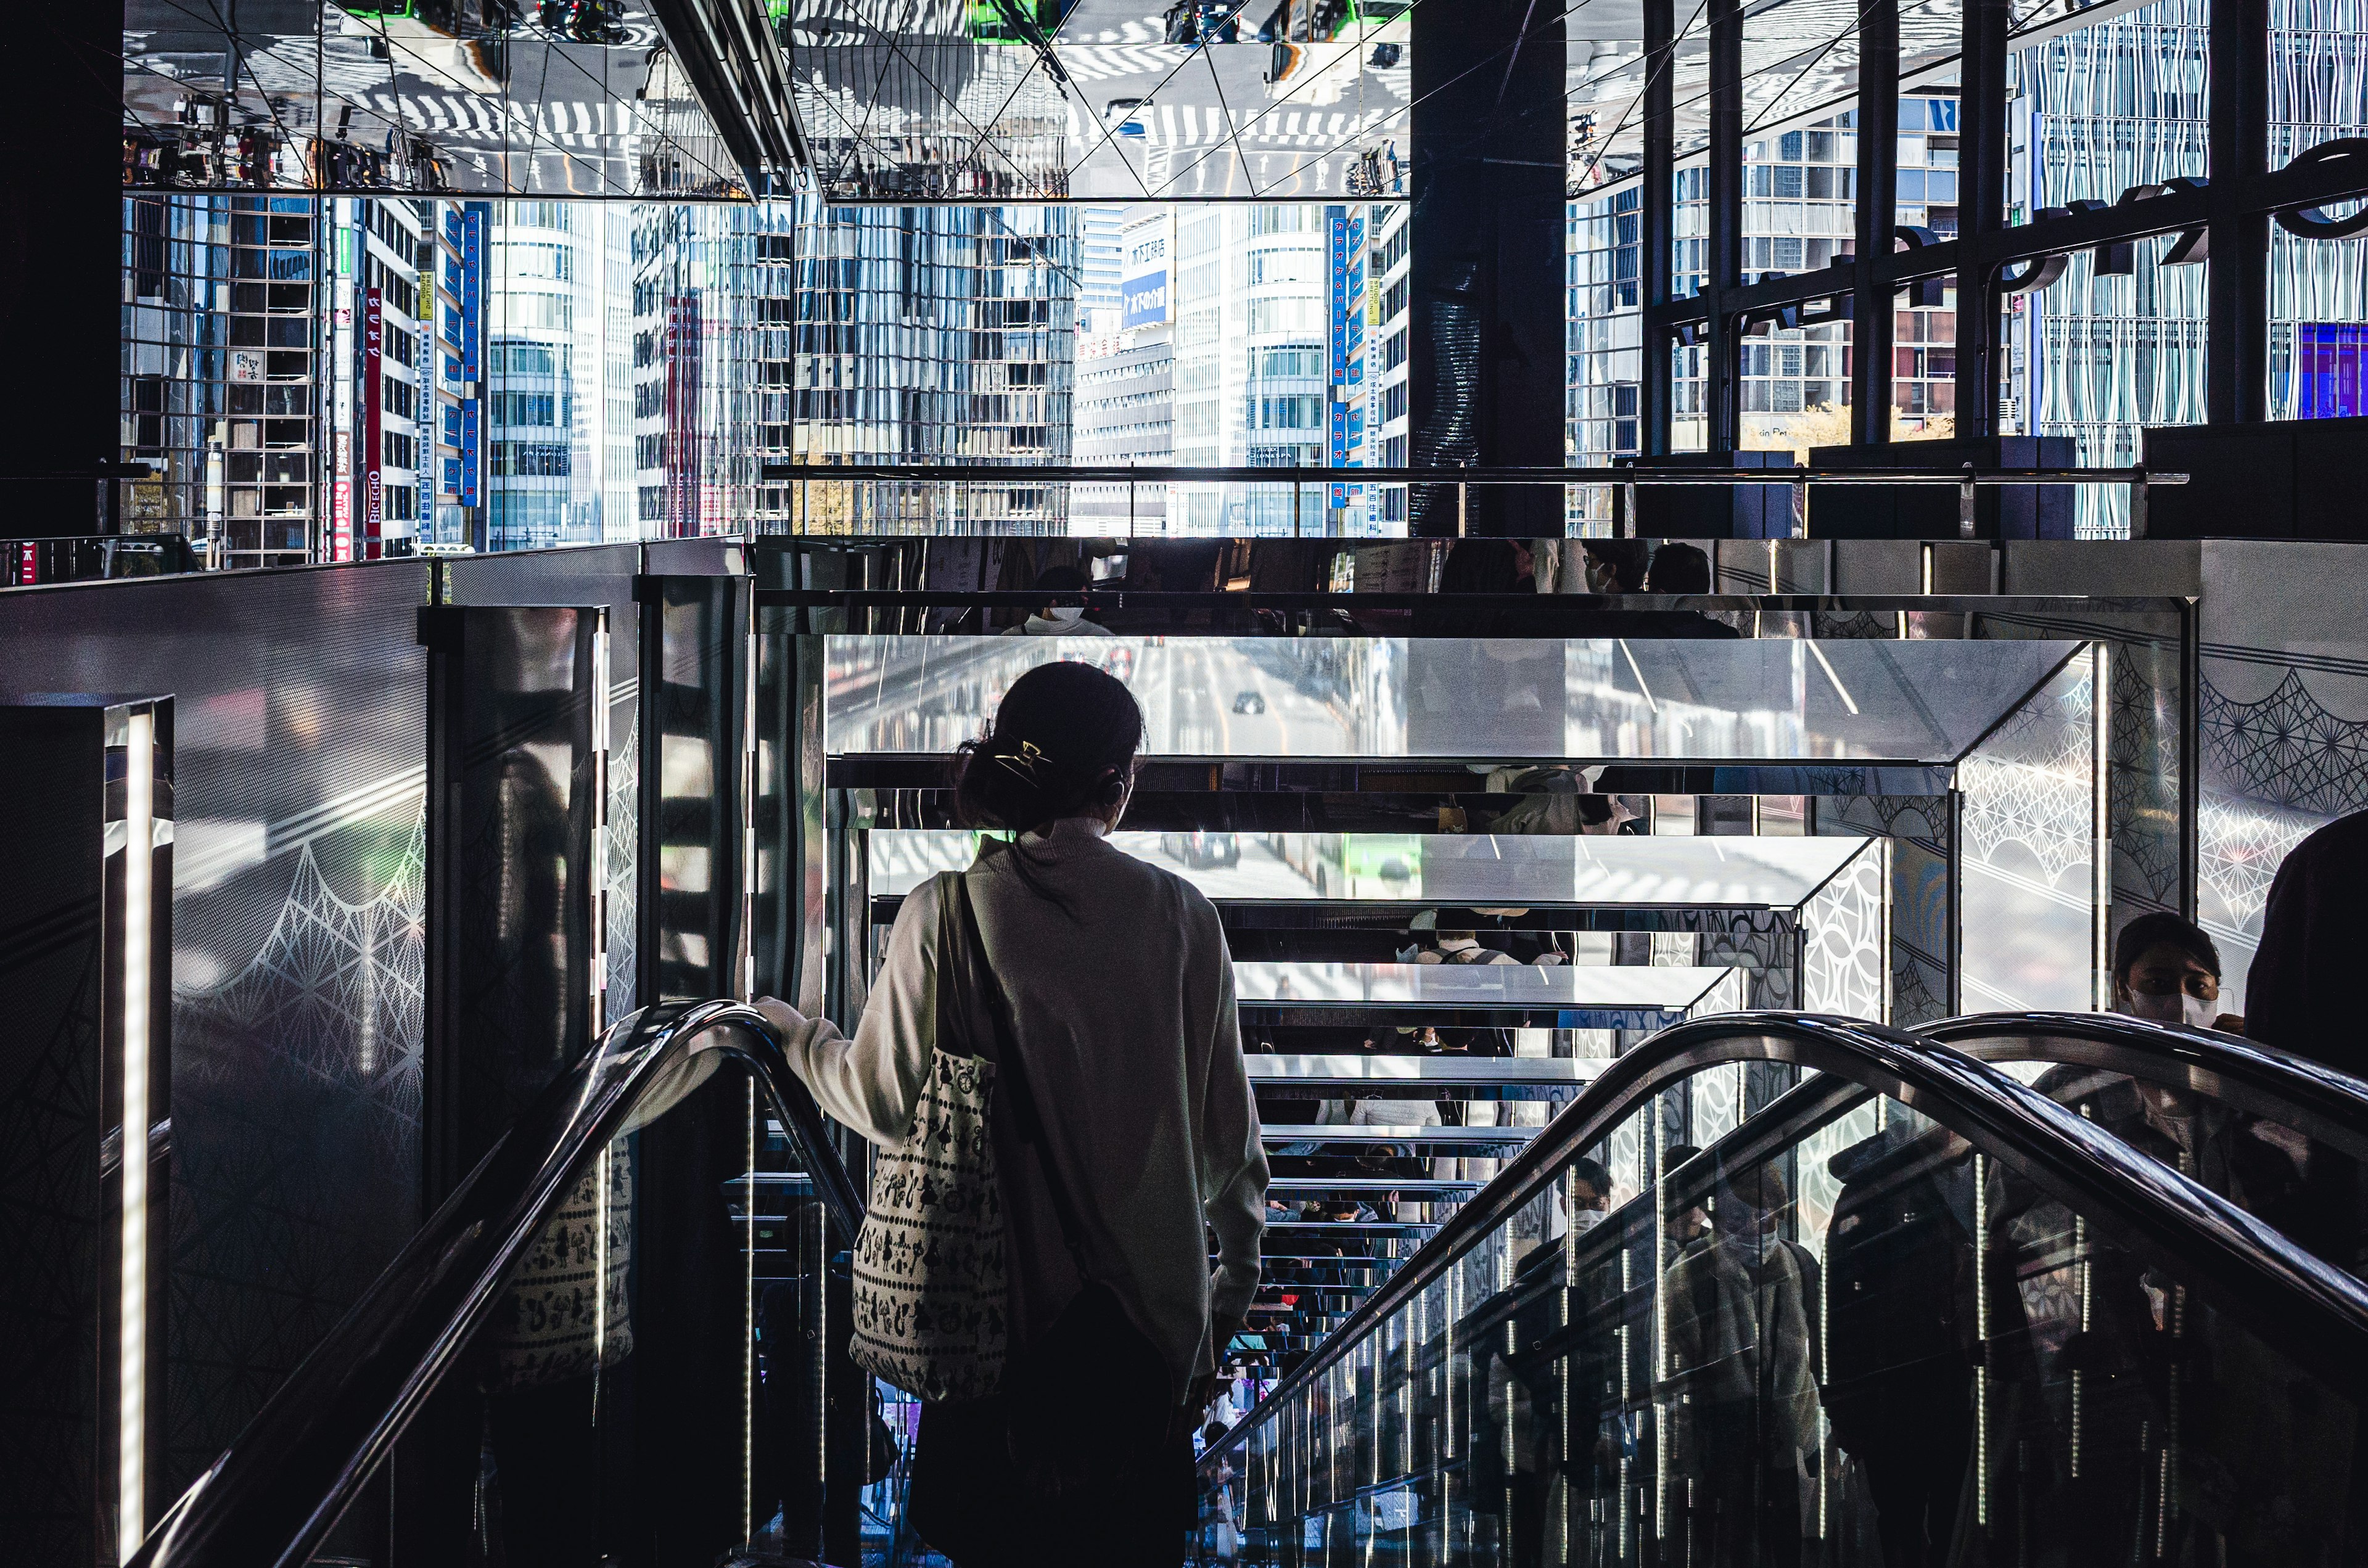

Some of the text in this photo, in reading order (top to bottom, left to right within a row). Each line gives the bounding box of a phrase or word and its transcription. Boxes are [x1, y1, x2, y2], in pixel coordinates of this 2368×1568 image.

[1132, 238, 1165, 266] 木下工務店
[1130, 285, 1166, 315] 木下の介護
[1334, 222, 1343, 377] カラオケ&パーティー館
[1334, 413, 1342, 496] カラオ館
